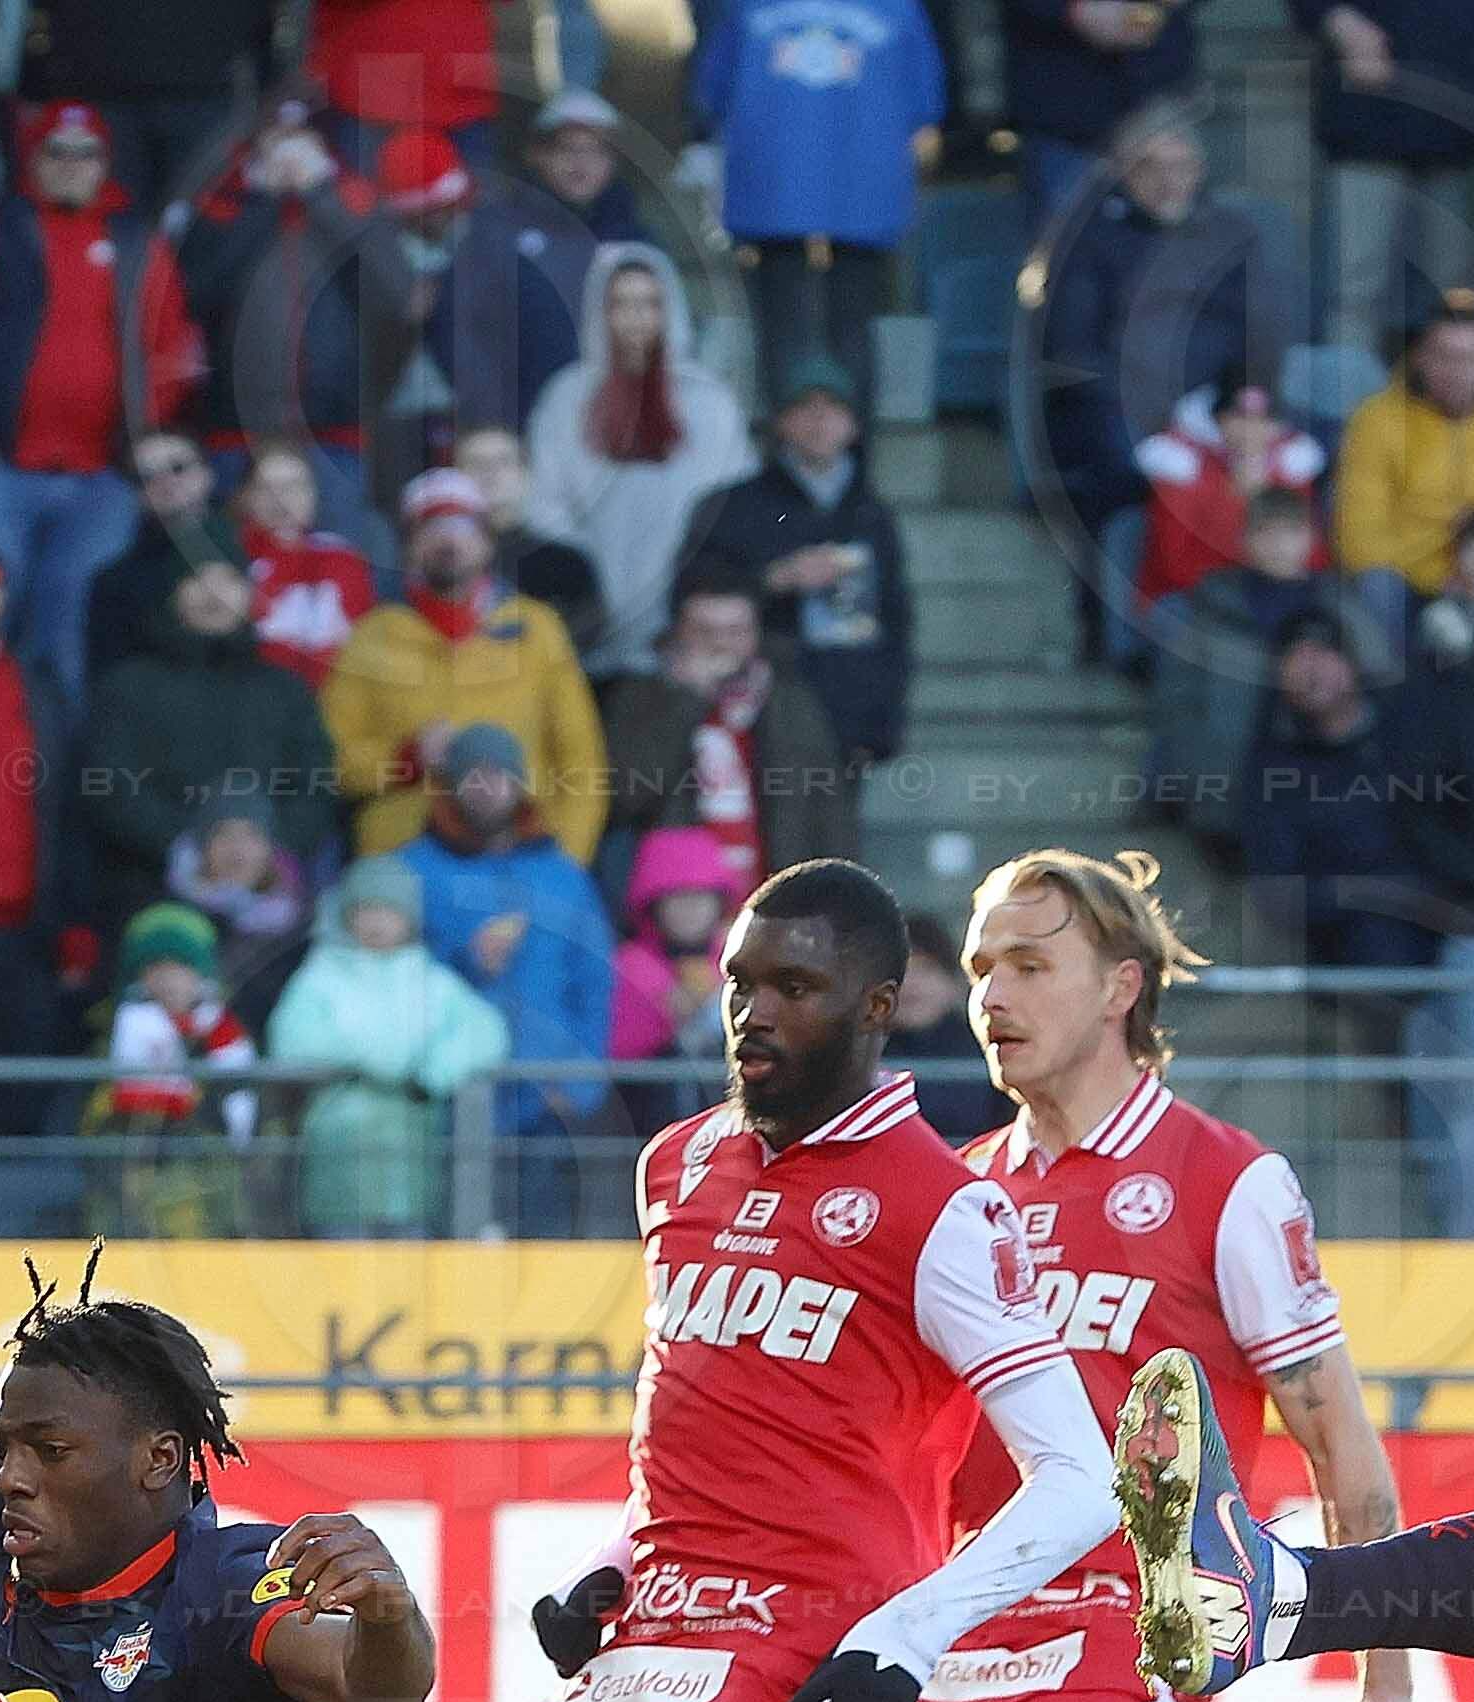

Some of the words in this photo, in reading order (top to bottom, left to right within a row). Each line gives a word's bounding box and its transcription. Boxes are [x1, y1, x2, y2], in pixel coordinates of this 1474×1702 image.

[321, 1304, 640, 1418] Karn
[656, 1262, 860, 1365] MAPEI
[1035, 1270, 1157, 1356] PEI
